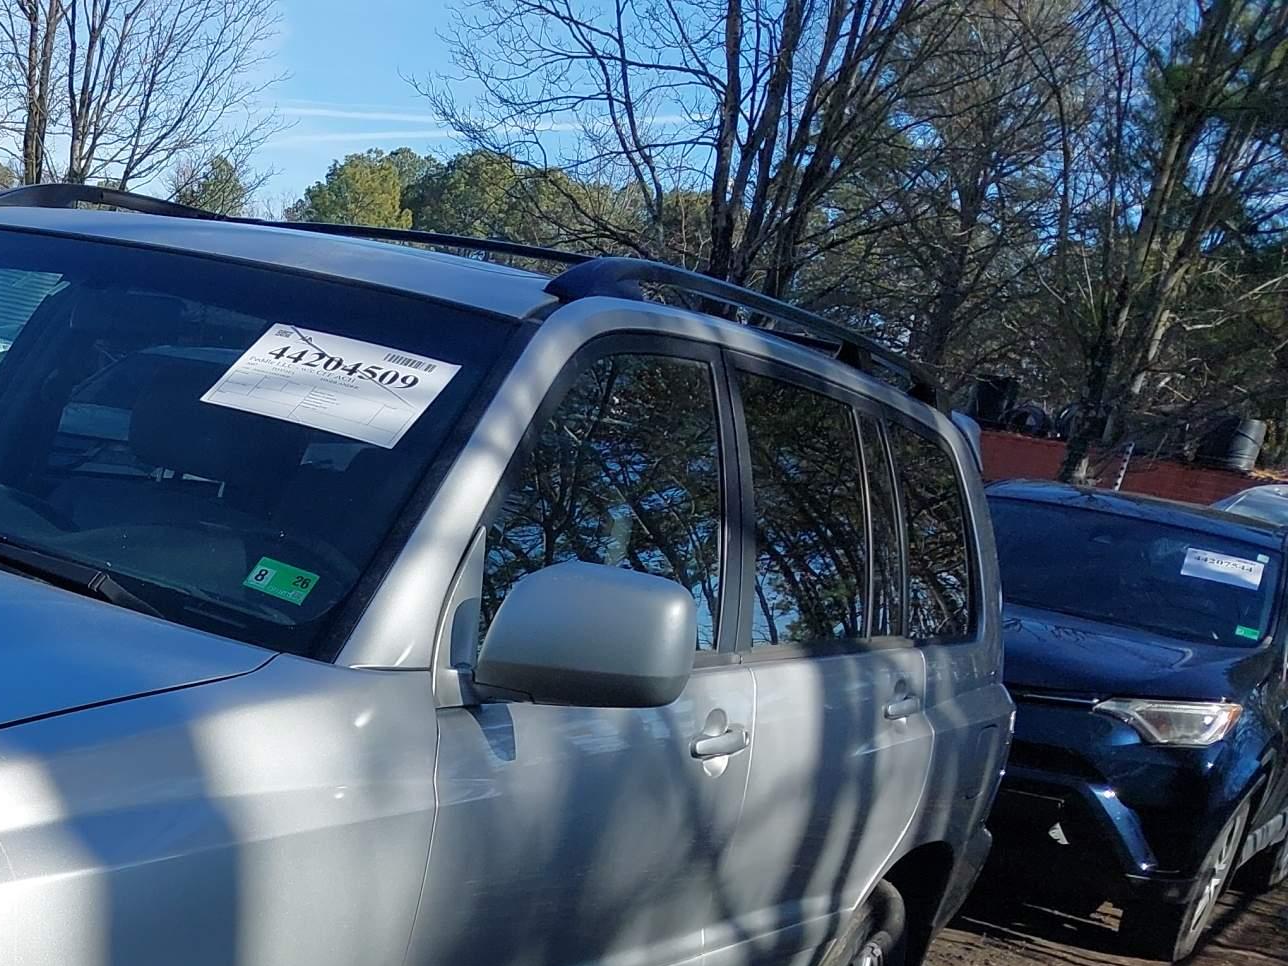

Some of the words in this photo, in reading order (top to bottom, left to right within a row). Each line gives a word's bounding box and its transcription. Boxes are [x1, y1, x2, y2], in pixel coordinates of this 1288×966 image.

[268, 345, 419, 389] 44204509
[254, 569, 269, 582] 8
[292, 575, 312, 589] 26
